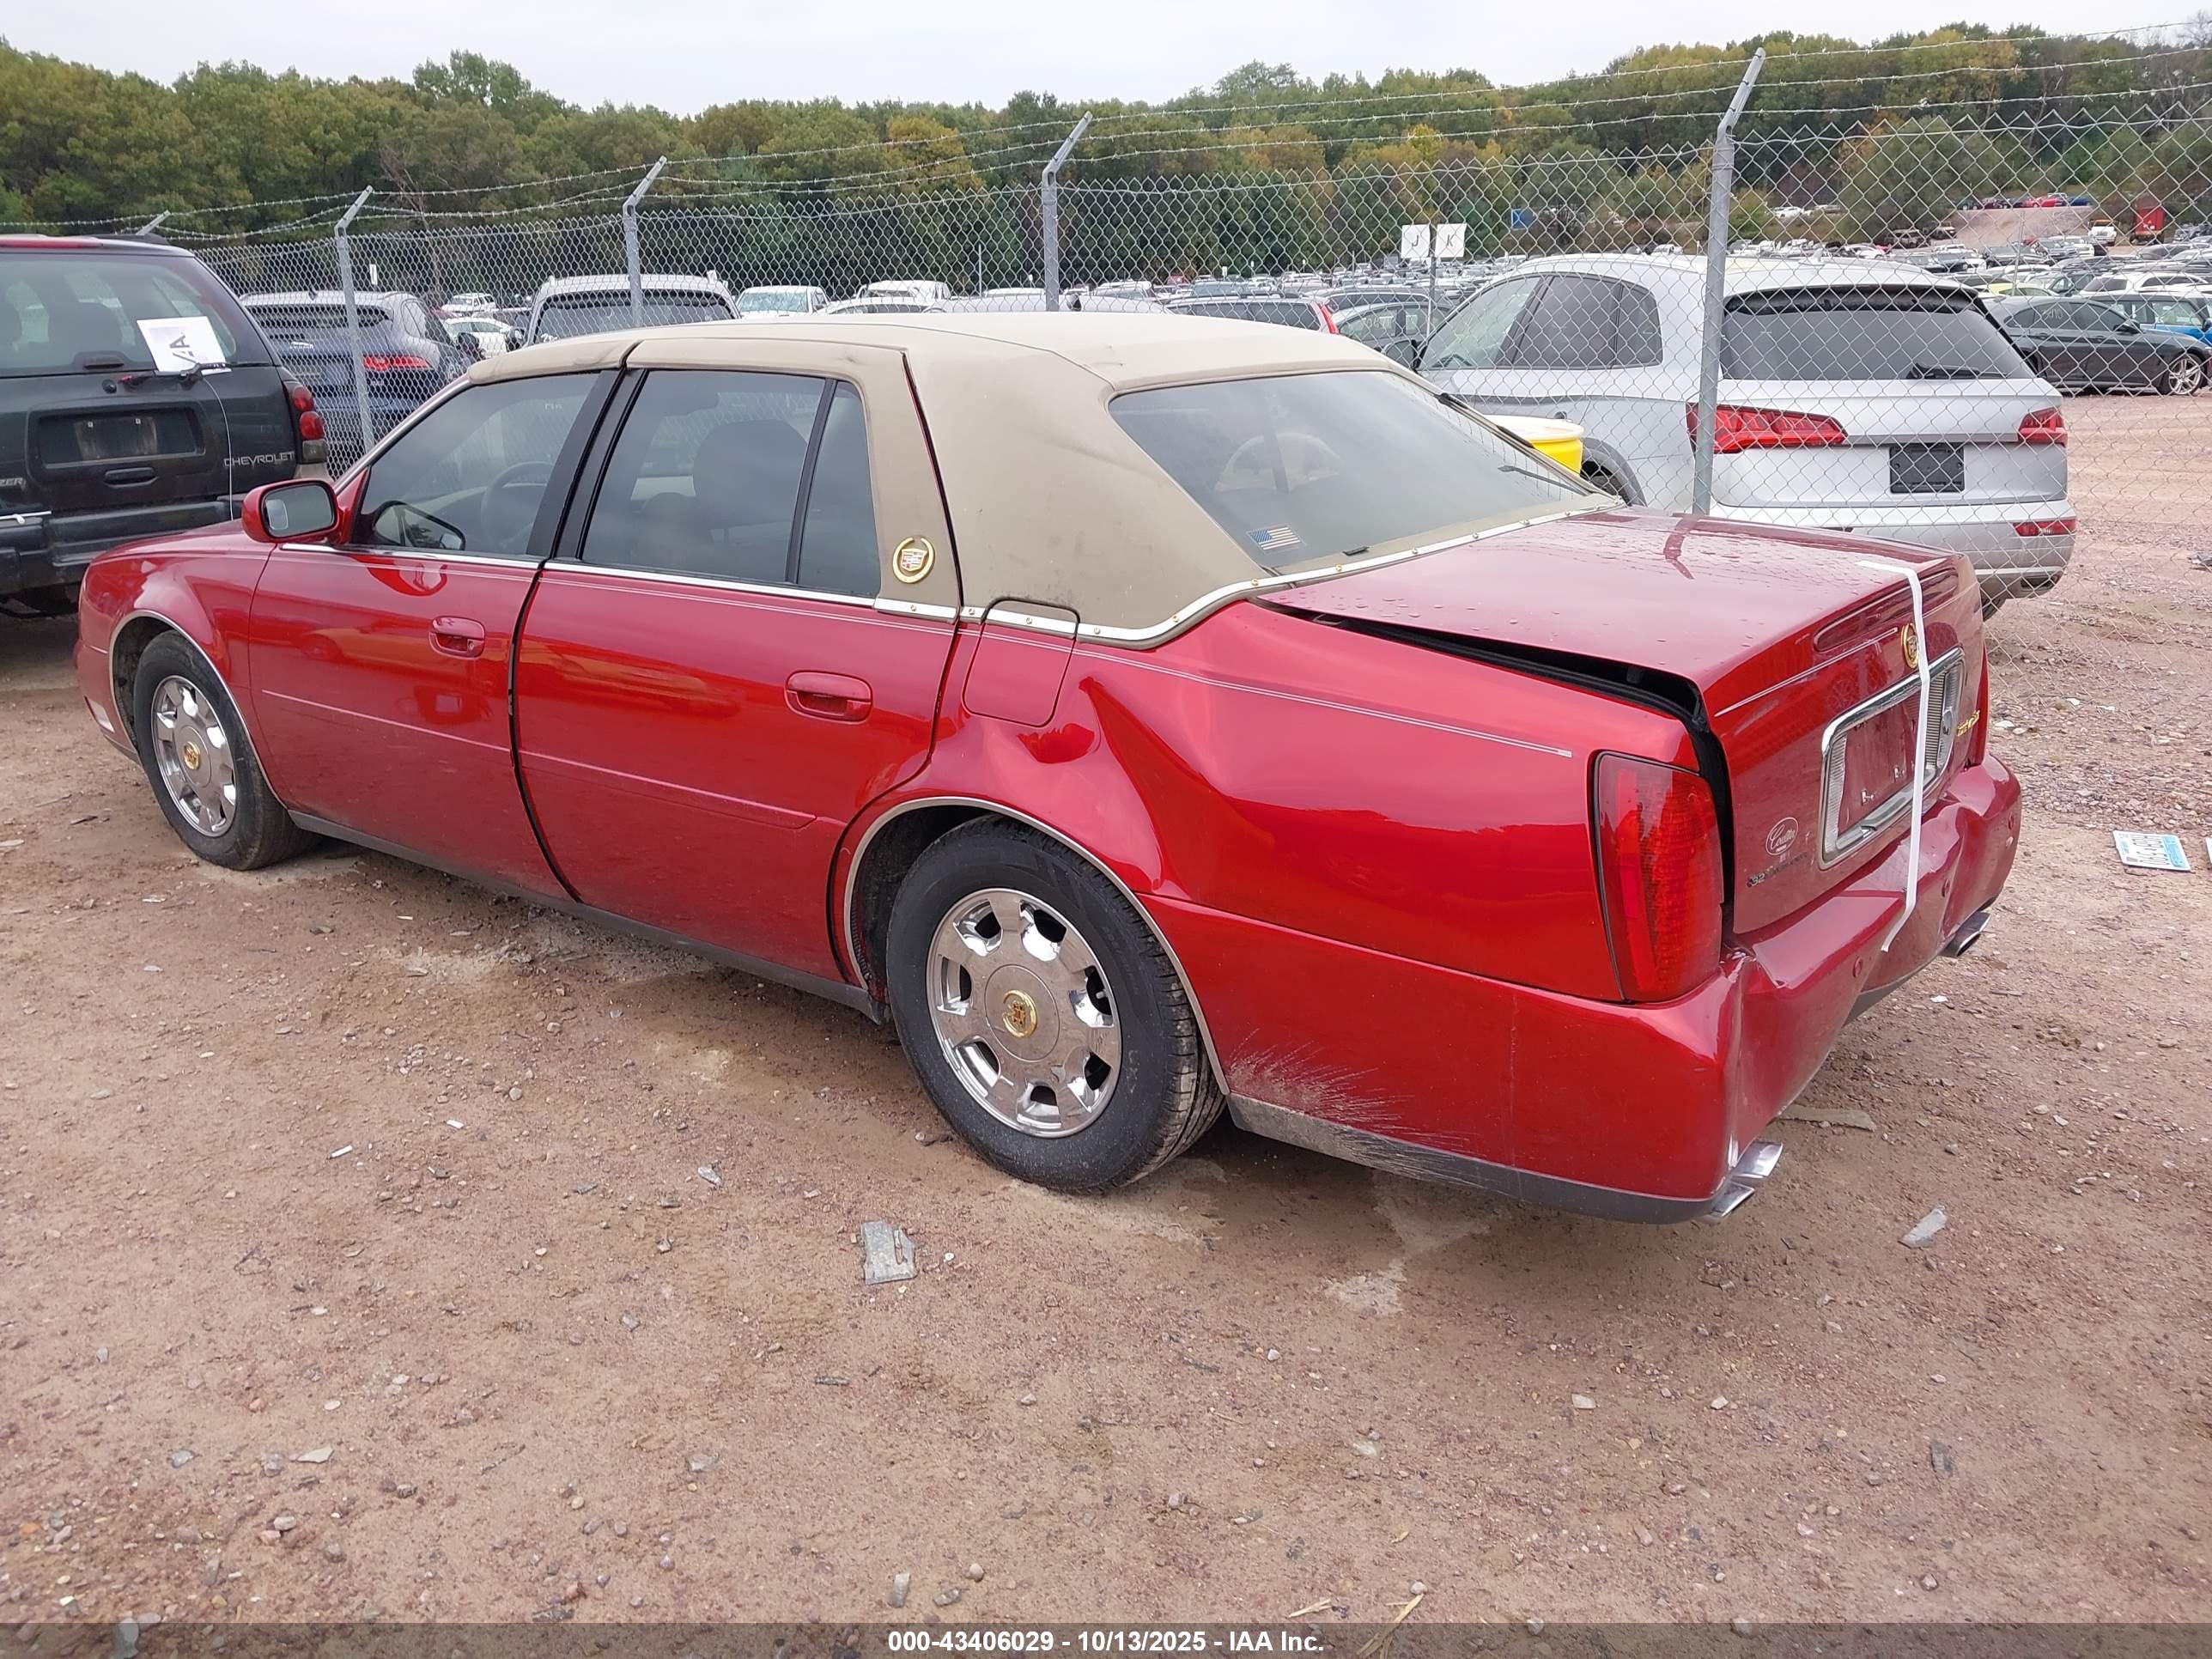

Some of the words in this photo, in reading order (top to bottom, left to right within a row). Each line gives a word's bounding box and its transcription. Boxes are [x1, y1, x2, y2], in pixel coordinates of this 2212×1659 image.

[1412, 234, 1419, 247] J
[1446, 234, 1456, 247] K
[223, 451, 295, 468] CHEVROLET
